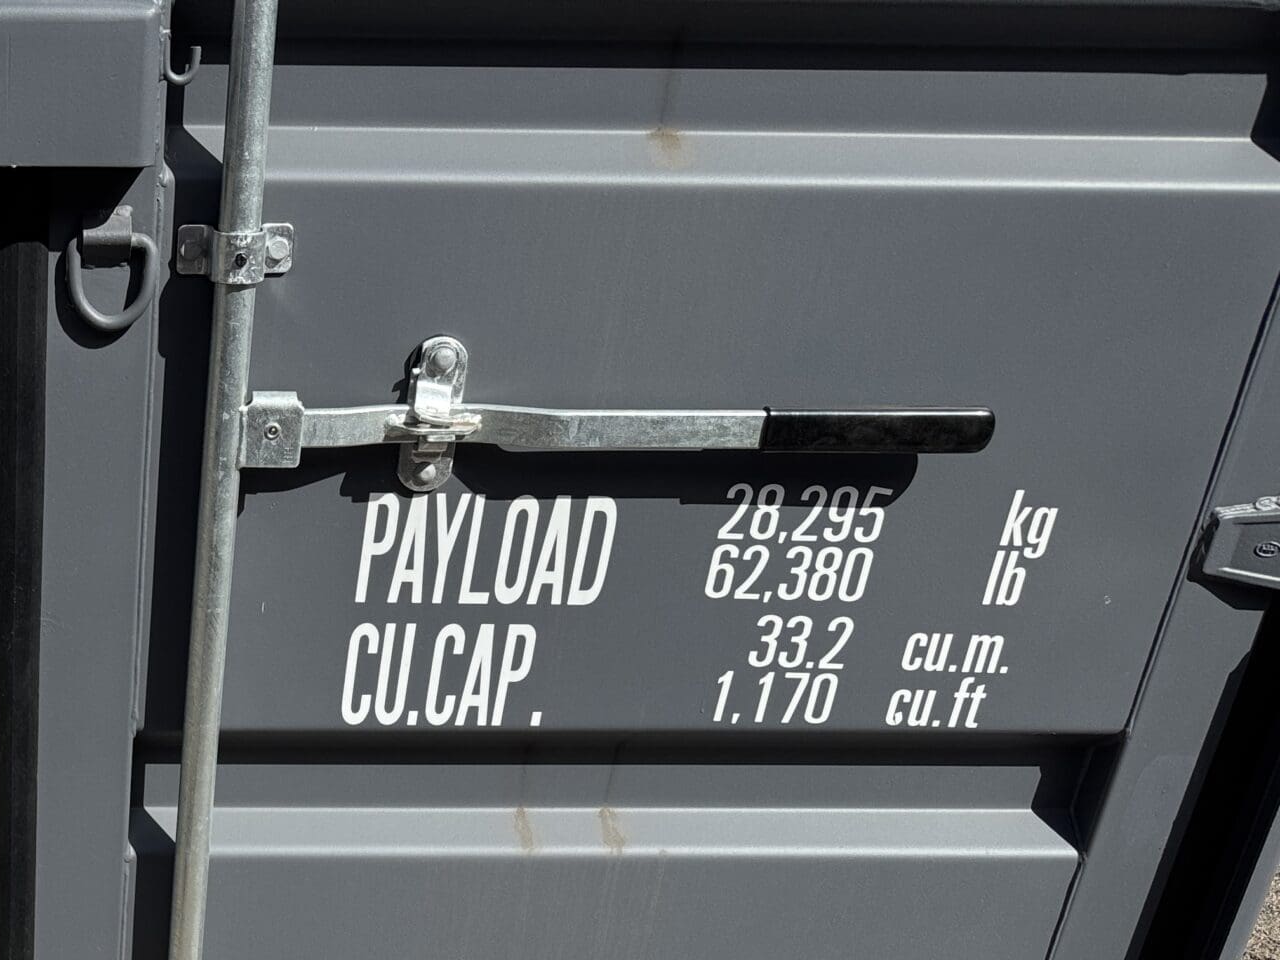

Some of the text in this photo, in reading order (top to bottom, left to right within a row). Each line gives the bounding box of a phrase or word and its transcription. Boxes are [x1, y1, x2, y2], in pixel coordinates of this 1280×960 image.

[354, 483, 1058, 605] PAYLOAD 28,295 kg
[704, 544, 1027, 606] 62,380 lb
[748, 615, 855, 670] 33.2
[902, 631, 1010, 675] cu.m.
[713, 671, 987, 729] 1,170 cu.ft
